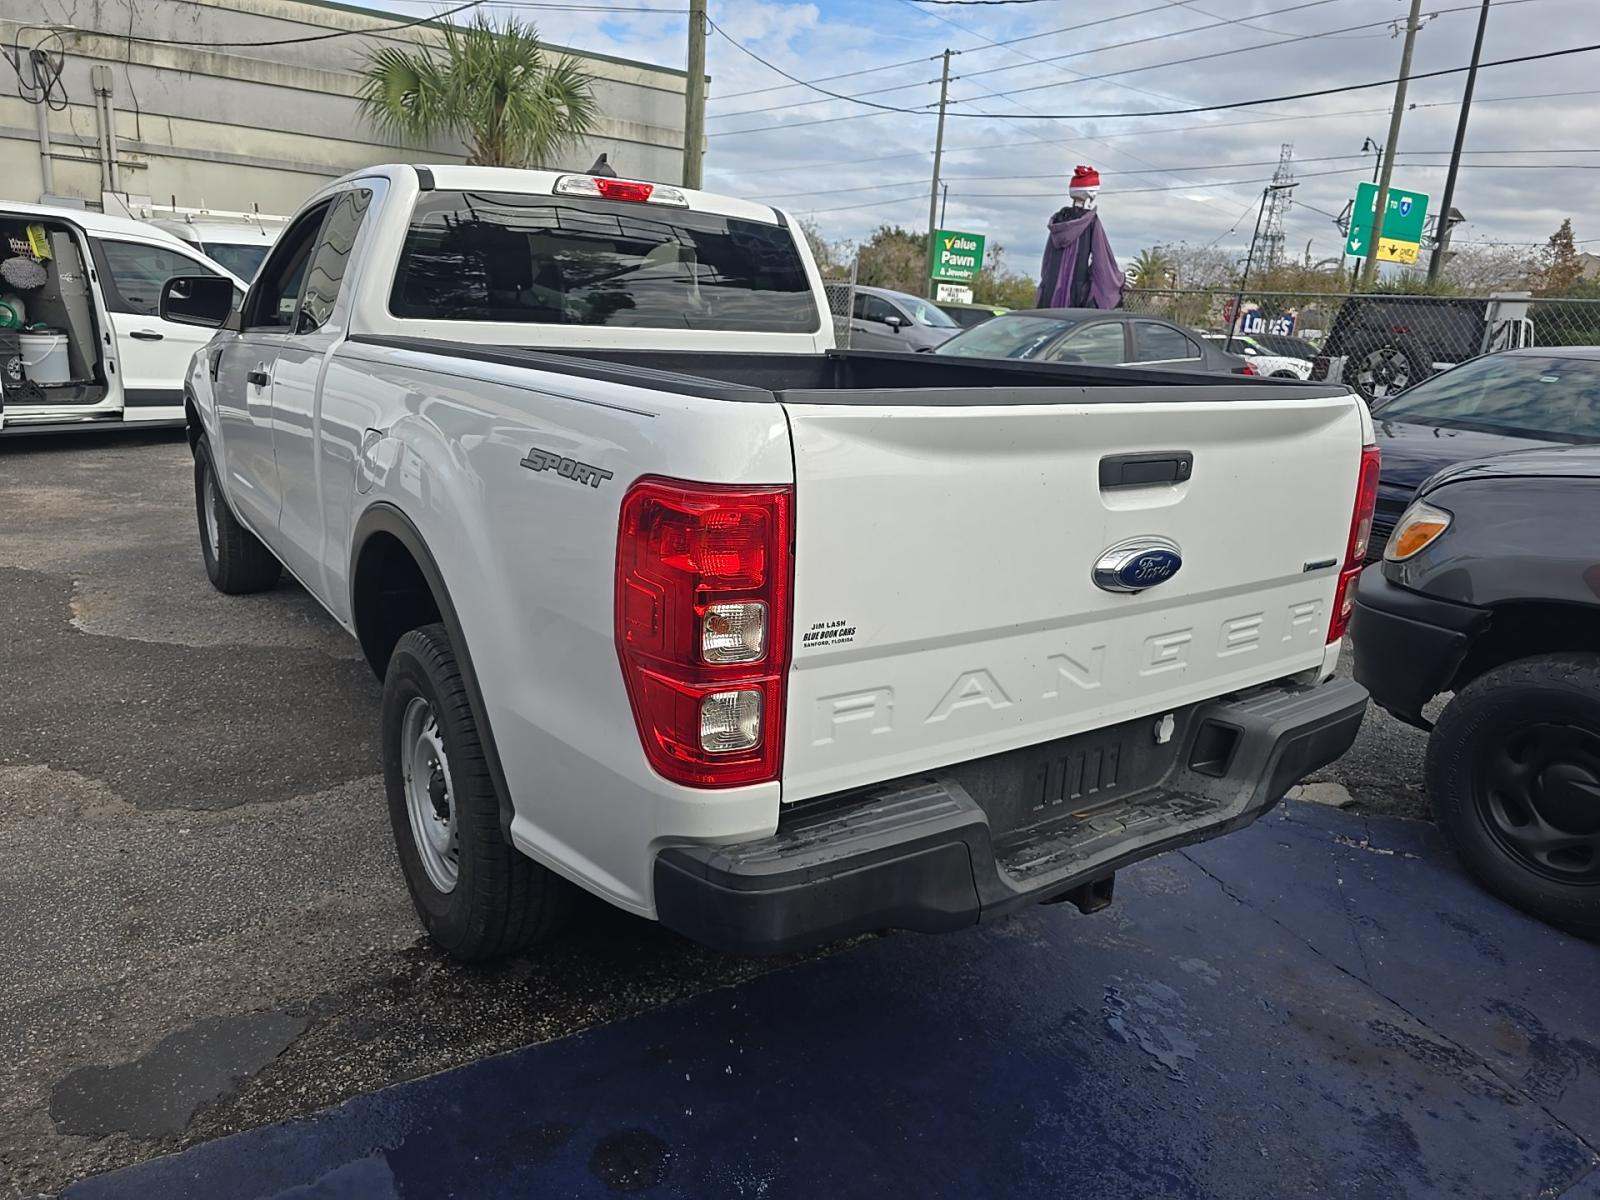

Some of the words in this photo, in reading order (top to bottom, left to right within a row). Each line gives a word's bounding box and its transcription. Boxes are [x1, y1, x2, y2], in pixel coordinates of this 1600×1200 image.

[1390, 200, 1398, 209] TO
[944, 236, 976, 250] Value
[941, 250, 975, 267] Pawn
[520, 447, 614, 489] SPORT
[1134, 556, 1172, 579] Ford
[803, 632, 820, 641] BLUE
[820, 630, 838, 639] BOOK
[838, 627, 856, 637] CARS
[811, 598, 1324, 746] RANGER
